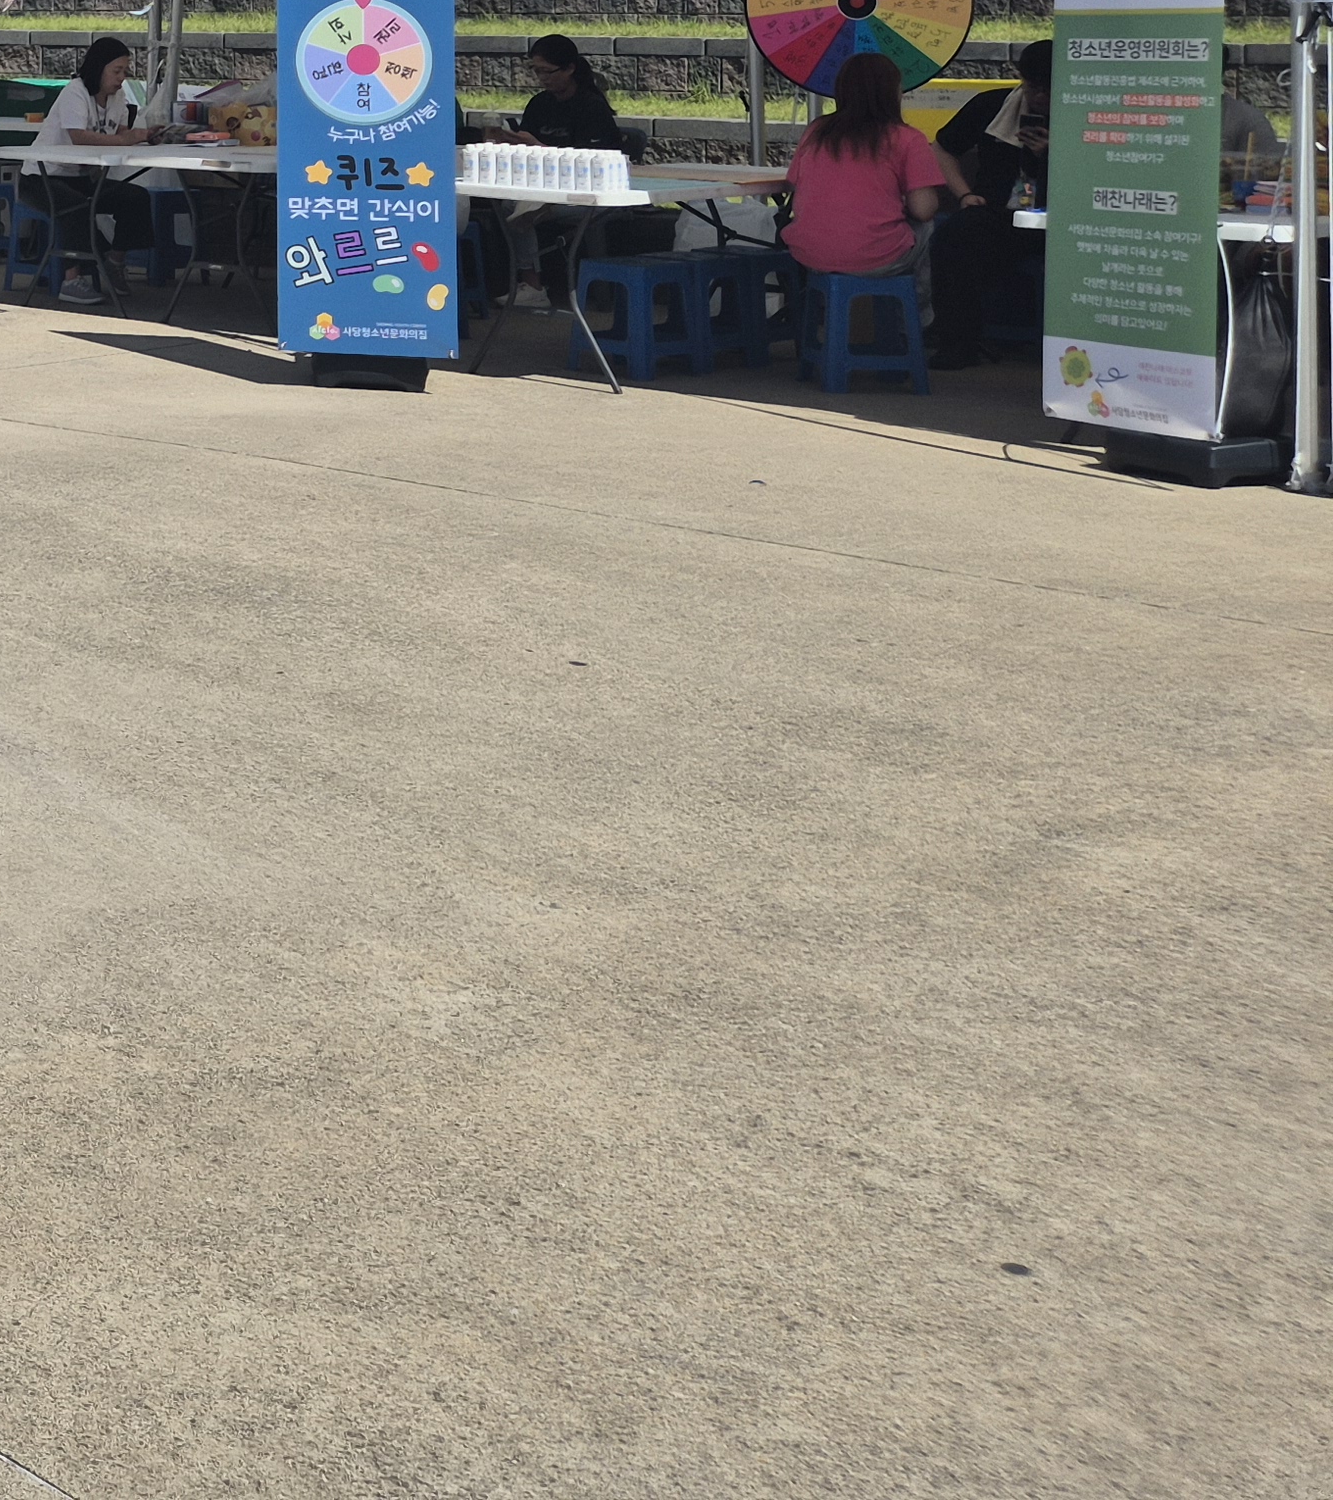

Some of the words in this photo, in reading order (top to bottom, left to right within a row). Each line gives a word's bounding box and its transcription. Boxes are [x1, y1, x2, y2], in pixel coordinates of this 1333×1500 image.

[327, 16, 353, 45] 사회
[373, 17, 402, 45] 권리
[1068, 40, 1209, 60] 청소년운영위원회는?
[312, 60, 345, 81] 환경
[384, 60, 418, 81] 정책
[356, 82, 372, 112] 참여
[327, 126, 376, 145] 누구나
[377, 99, 441, 142] 참여가능!
[336, 154, 406, 191] 퀴즈
[287, 196, 359, 221] 맞추면
[368, 198, 440, 224] 간식이
[1093, 189, 1178, 212] 해찬나래는?
[285, 225, 409, 288] 와르르
[342, 326, 428, 340] 사당청소년문화의집
